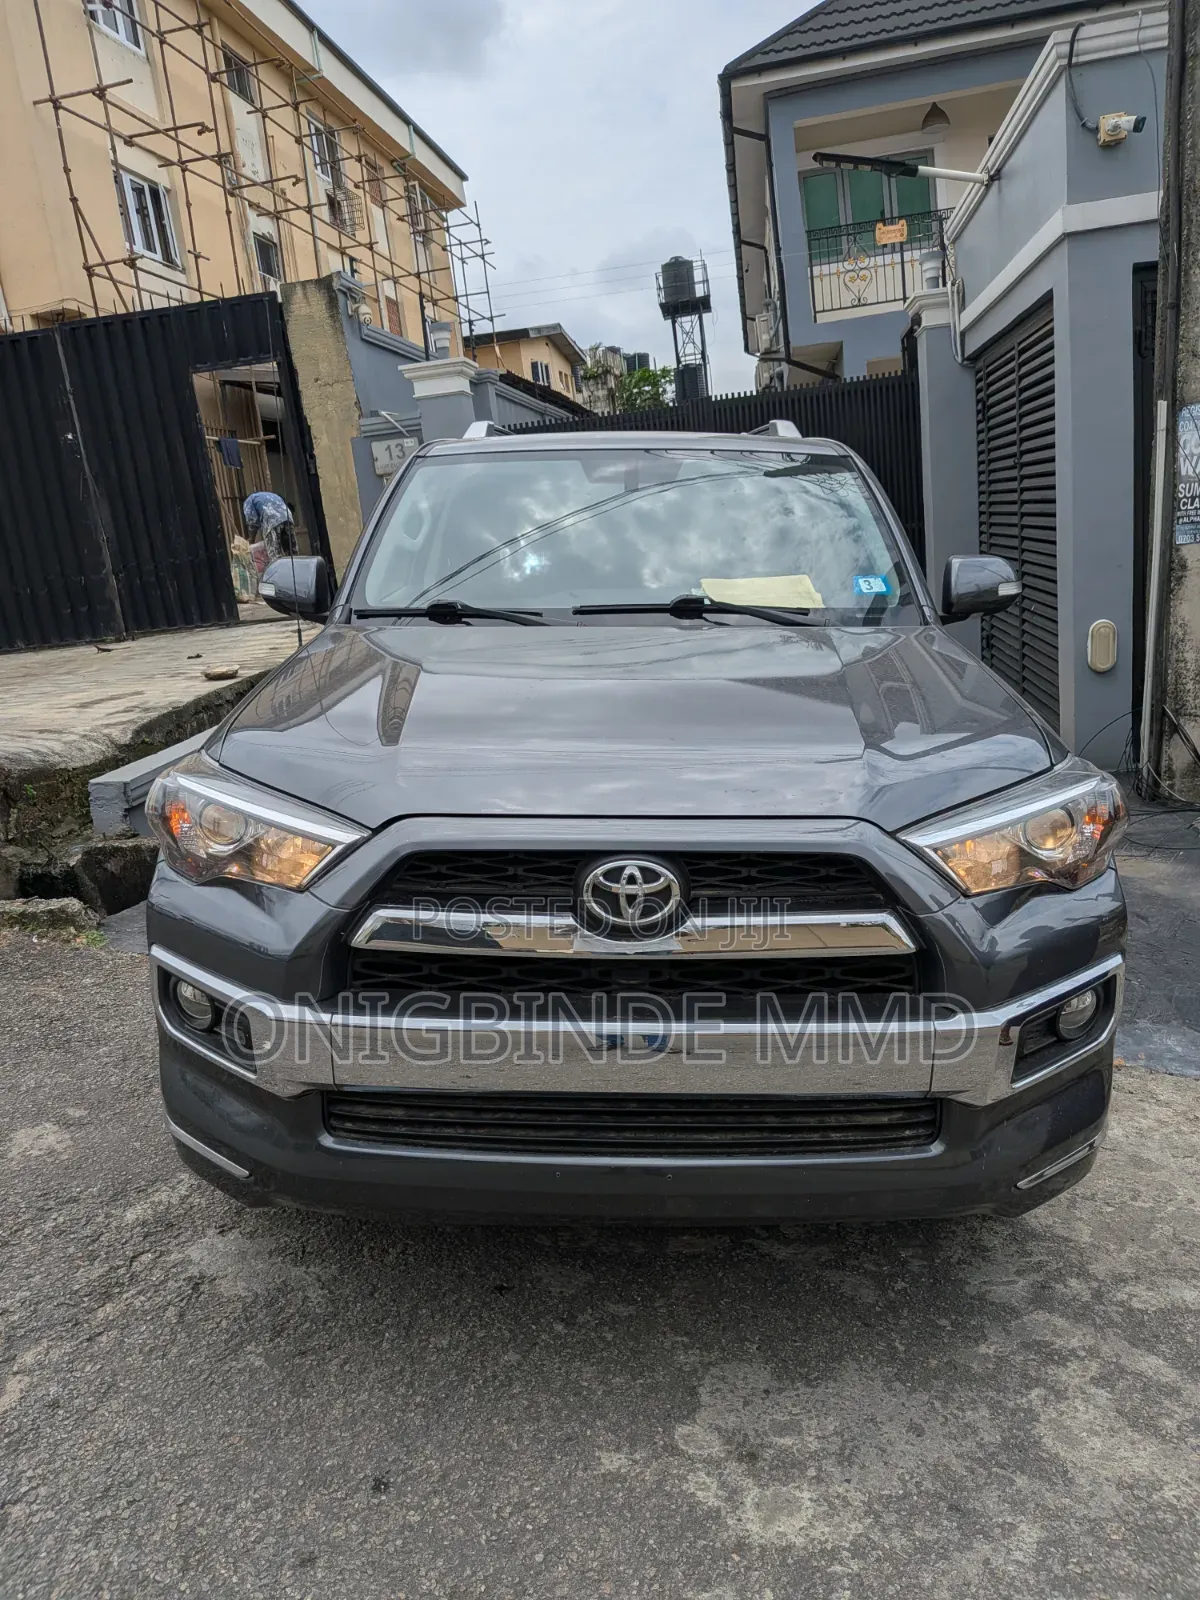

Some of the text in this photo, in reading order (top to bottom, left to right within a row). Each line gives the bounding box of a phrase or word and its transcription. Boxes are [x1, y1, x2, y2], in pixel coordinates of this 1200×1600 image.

[384, 443, 406, 460] 13
[1180, 498, 1200, 510] CLA
[864, 580, 874, 590] 3
